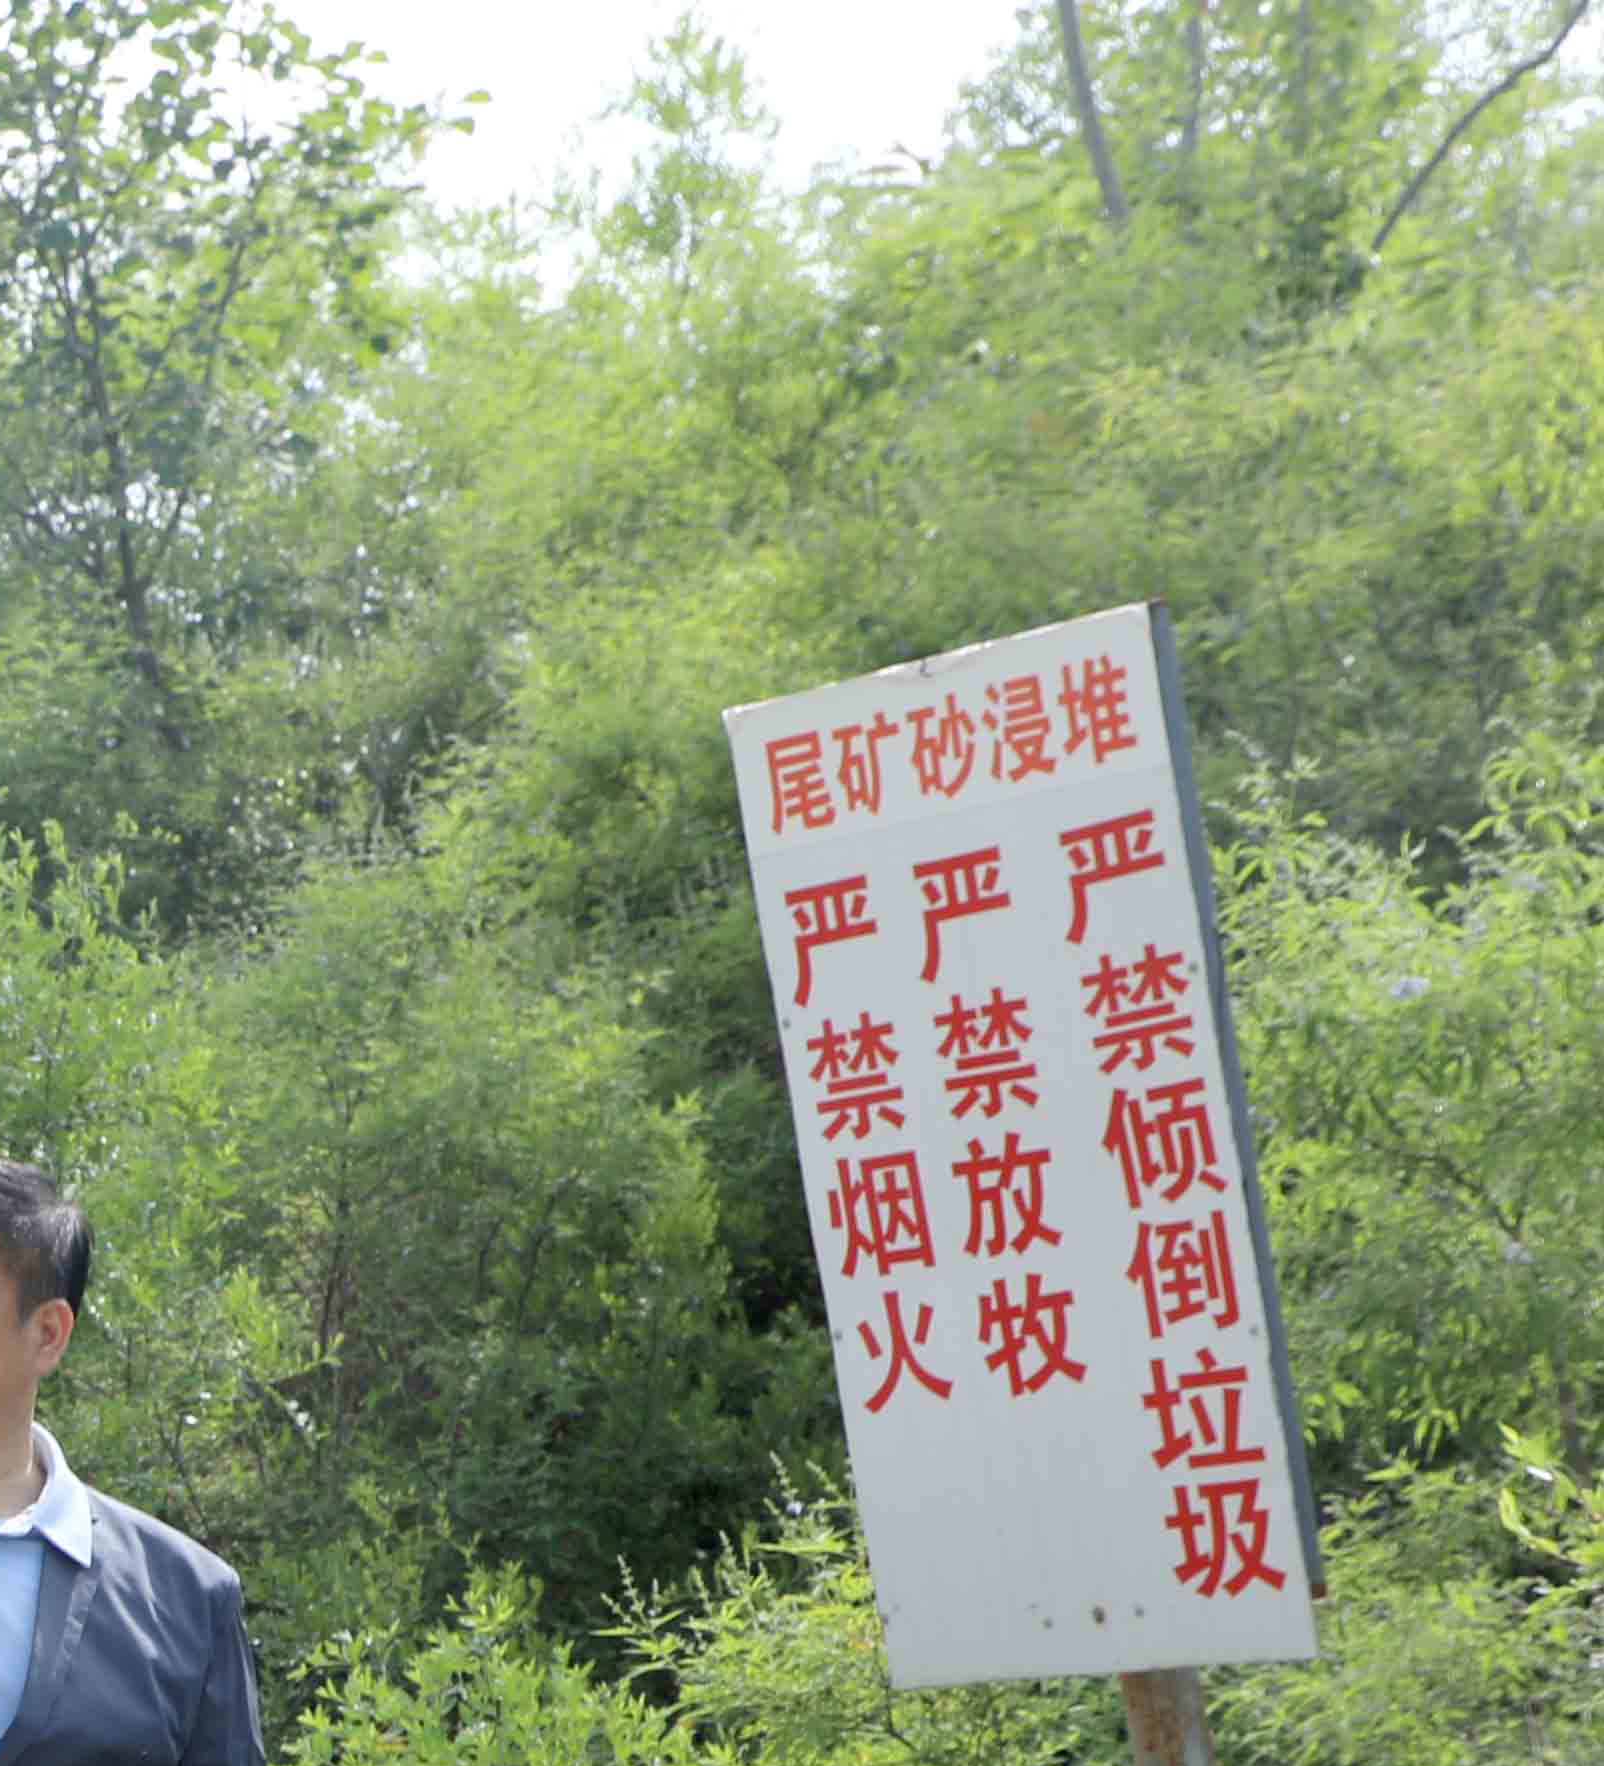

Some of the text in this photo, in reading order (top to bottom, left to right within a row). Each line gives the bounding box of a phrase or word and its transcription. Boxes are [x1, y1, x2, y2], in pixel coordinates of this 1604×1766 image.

[764, 655, 1137, 834] 尾矿砂浸堆
[784, 874, 954, 1414] 严禁烟火
[913, 846, 1087, 1396] 严禁放牧
[1059, 809, 1286, 1598] 严禁倾倒垃圾
